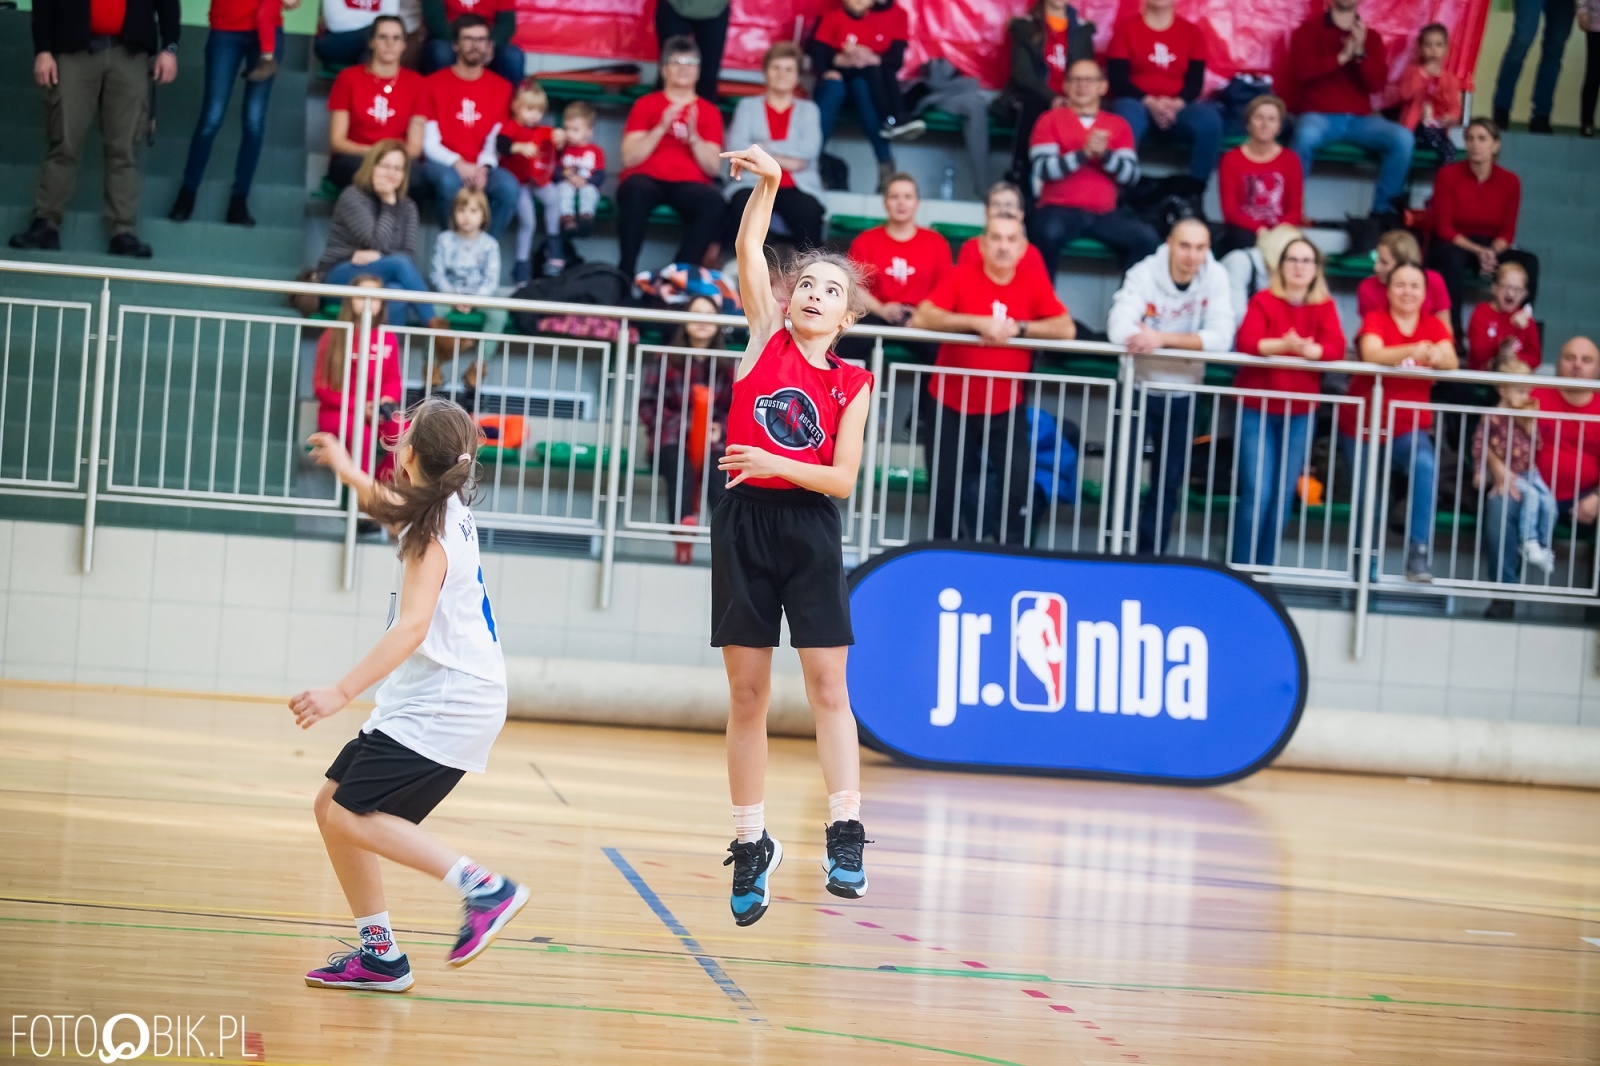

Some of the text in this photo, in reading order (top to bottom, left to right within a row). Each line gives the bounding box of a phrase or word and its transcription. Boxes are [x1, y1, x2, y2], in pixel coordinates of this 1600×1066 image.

[758, 399, 788, 411] HOUSTON
[798, 413, 822, 442] ROCKETS
[930, 587, 1209, 727] jr. nba
